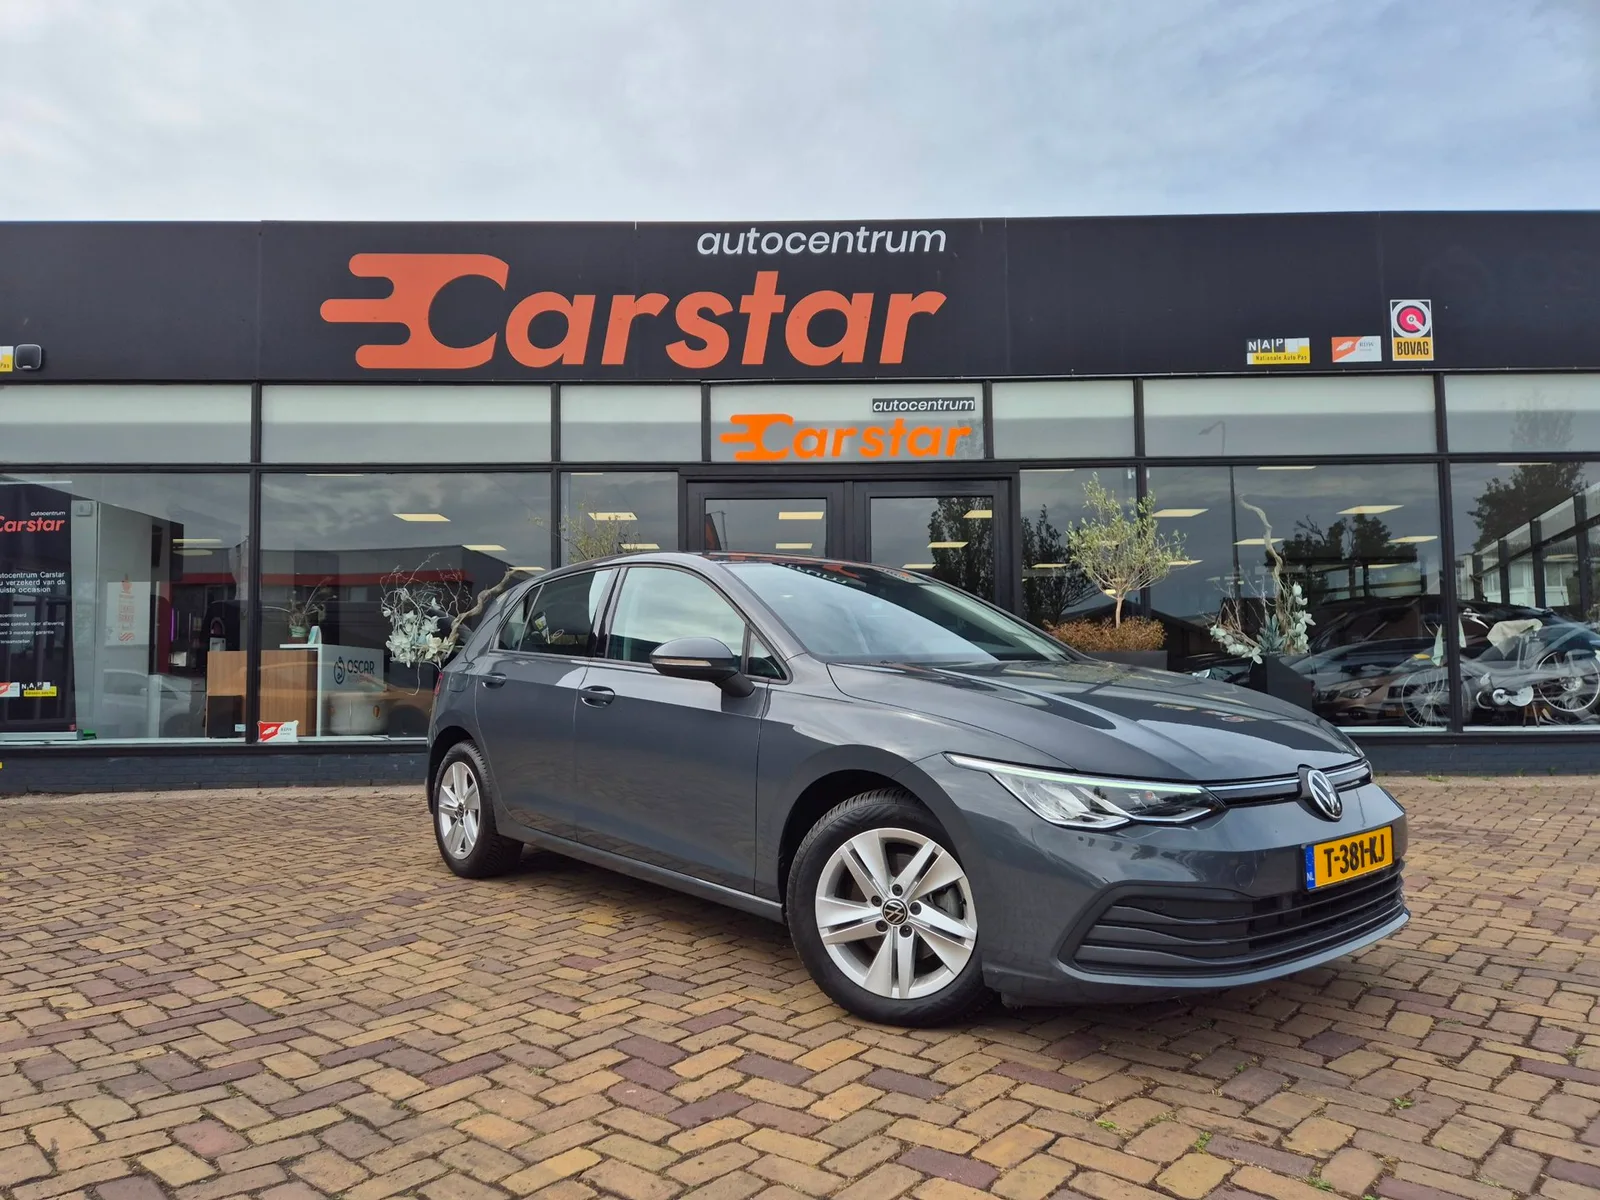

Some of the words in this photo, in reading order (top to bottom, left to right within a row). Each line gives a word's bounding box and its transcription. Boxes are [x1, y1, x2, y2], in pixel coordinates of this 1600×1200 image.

[697, 226, 947, 255] autocentrum
[320, 253, 948, 369] Carstar
[1396, 341, 1429, 356] BOVAG
[873, 399, 975, 411] autocentrum
[720, 413, 973, 460] Carstar
[0, 516, 65, 532] arstar
[347, 659, 375, 675] OSCAR
[1306, 872, 1315, 882] NL
[1323, 833, 1385, 878] T-381-KJ
